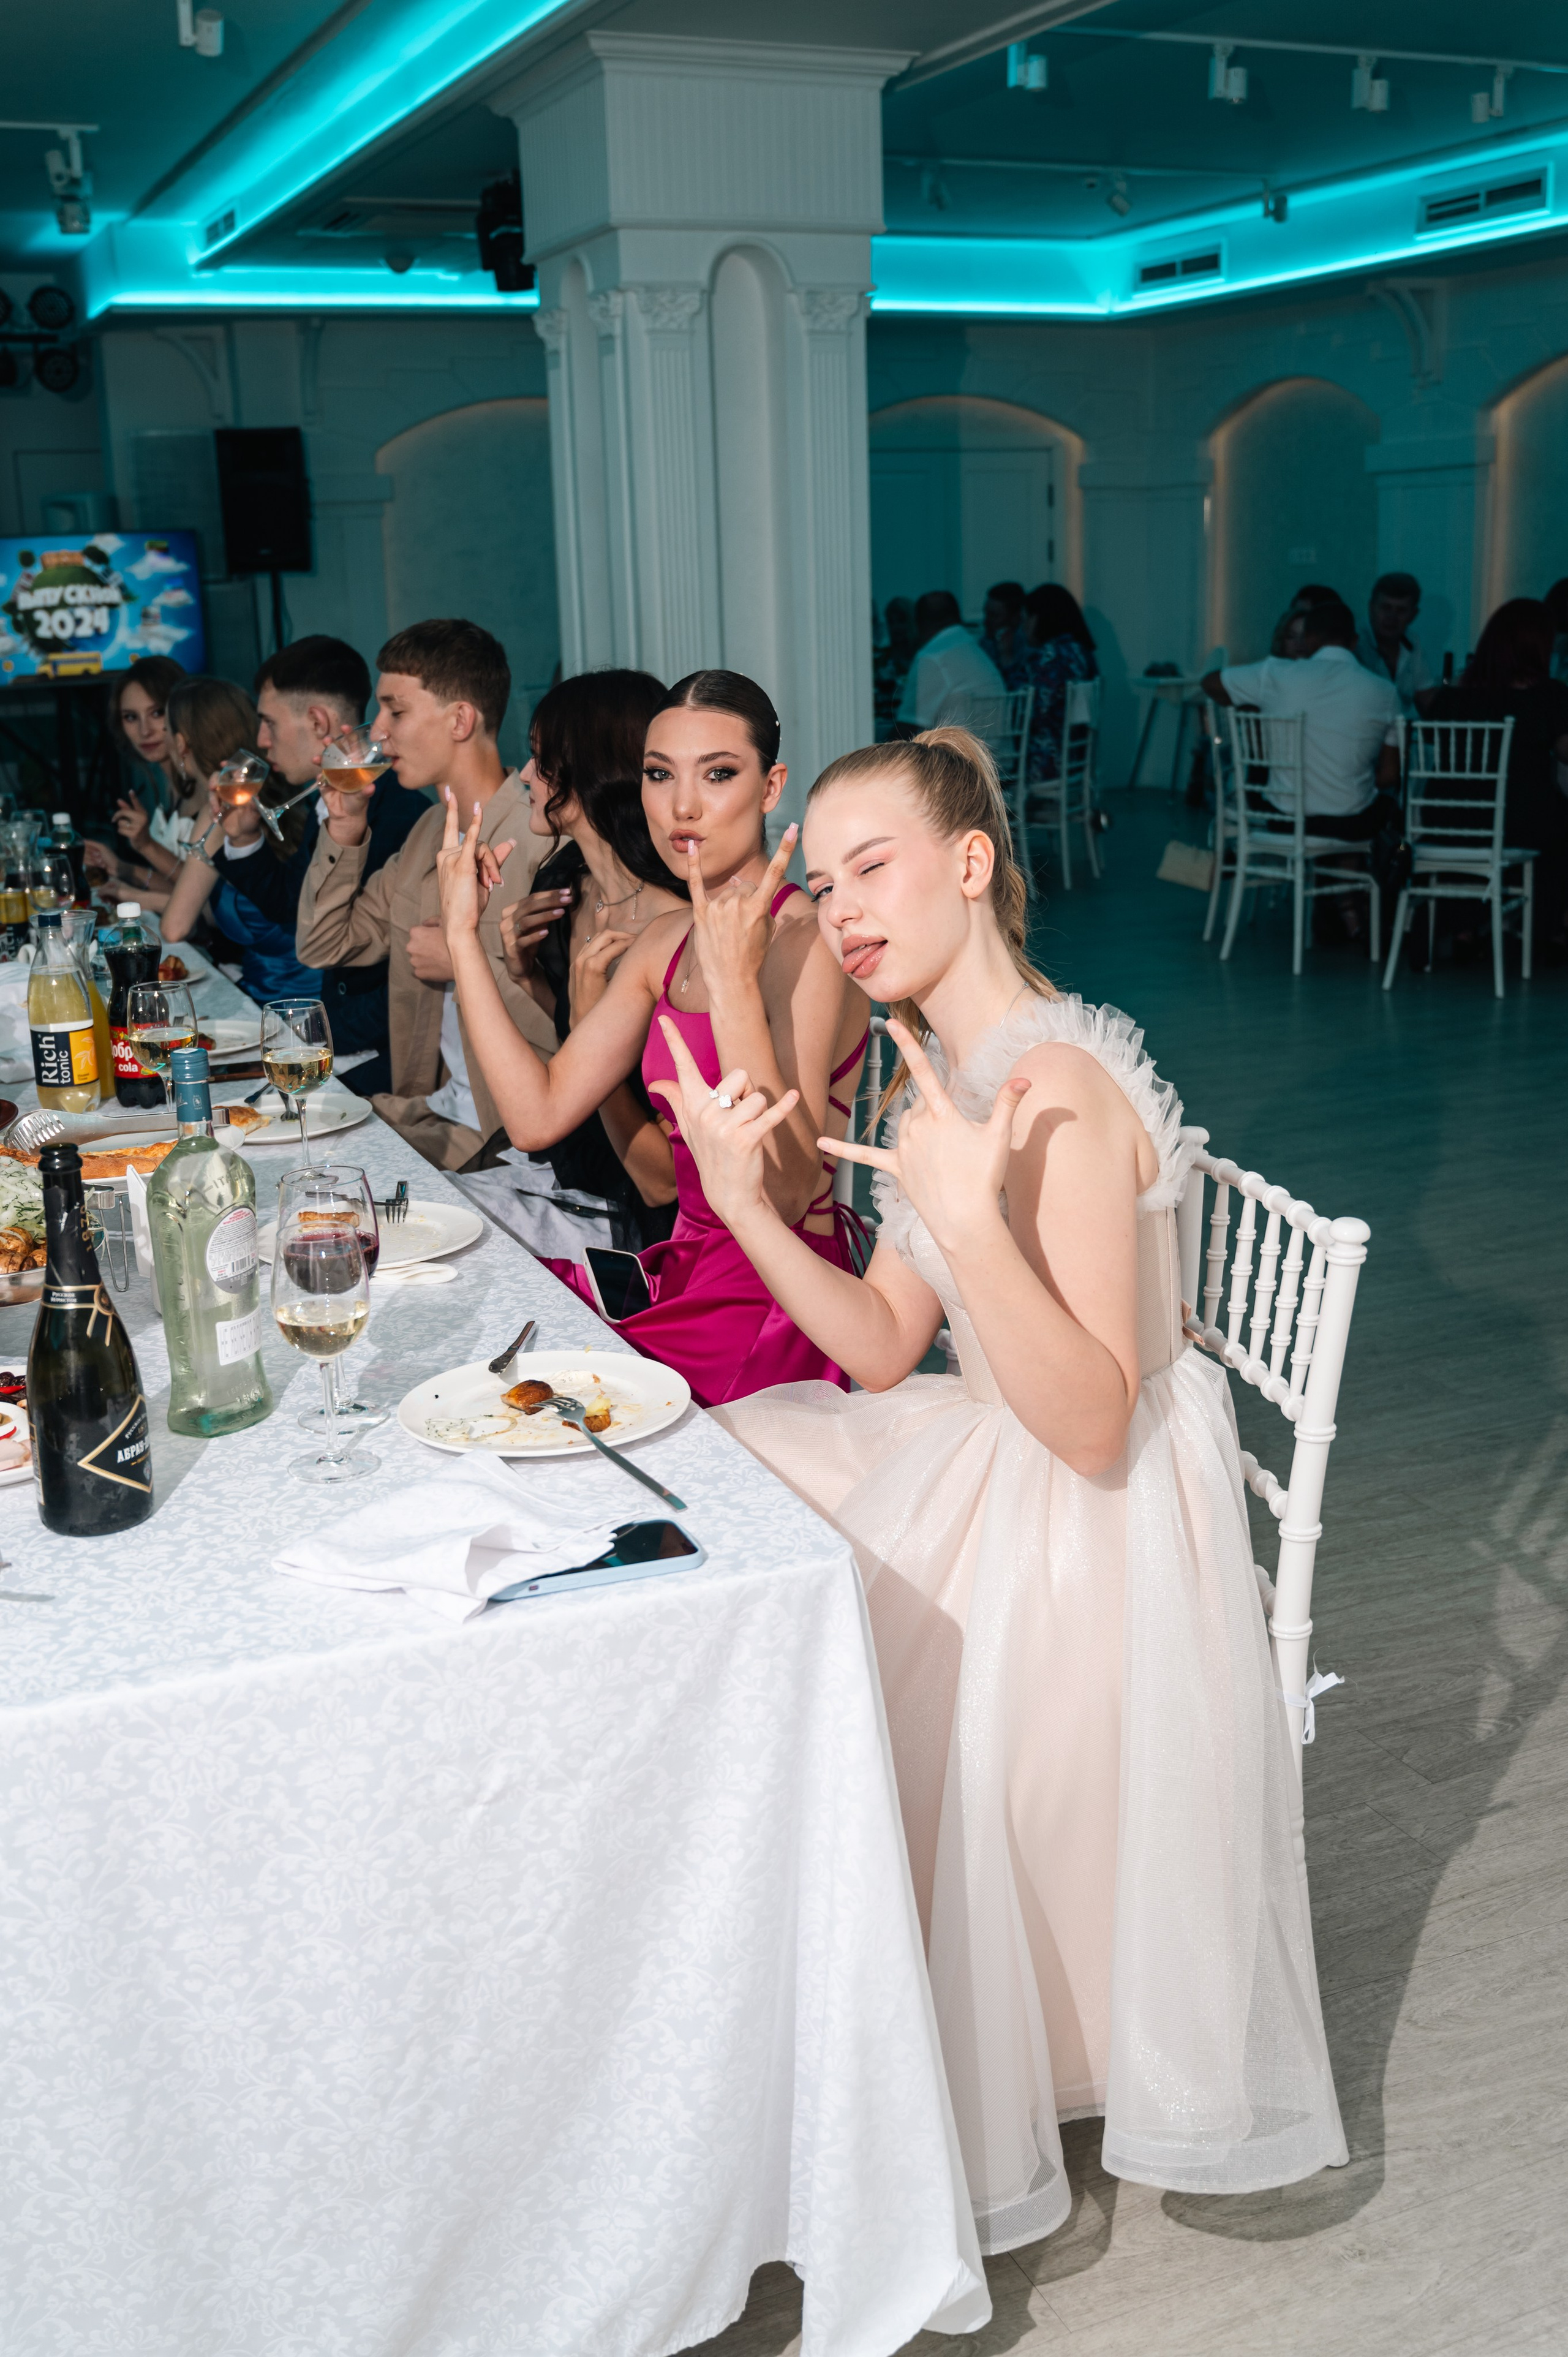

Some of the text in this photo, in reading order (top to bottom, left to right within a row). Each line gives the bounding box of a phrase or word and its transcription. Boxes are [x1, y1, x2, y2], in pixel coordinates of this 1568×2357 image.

[34, 606, 110, 638] 2024
[39, 1035, 59, 1084] Rich
[58, 1050, 70, 1084] tonic
[110, 1040, 133, 1062] обр
[118, 1062, 138, 1073] cola
